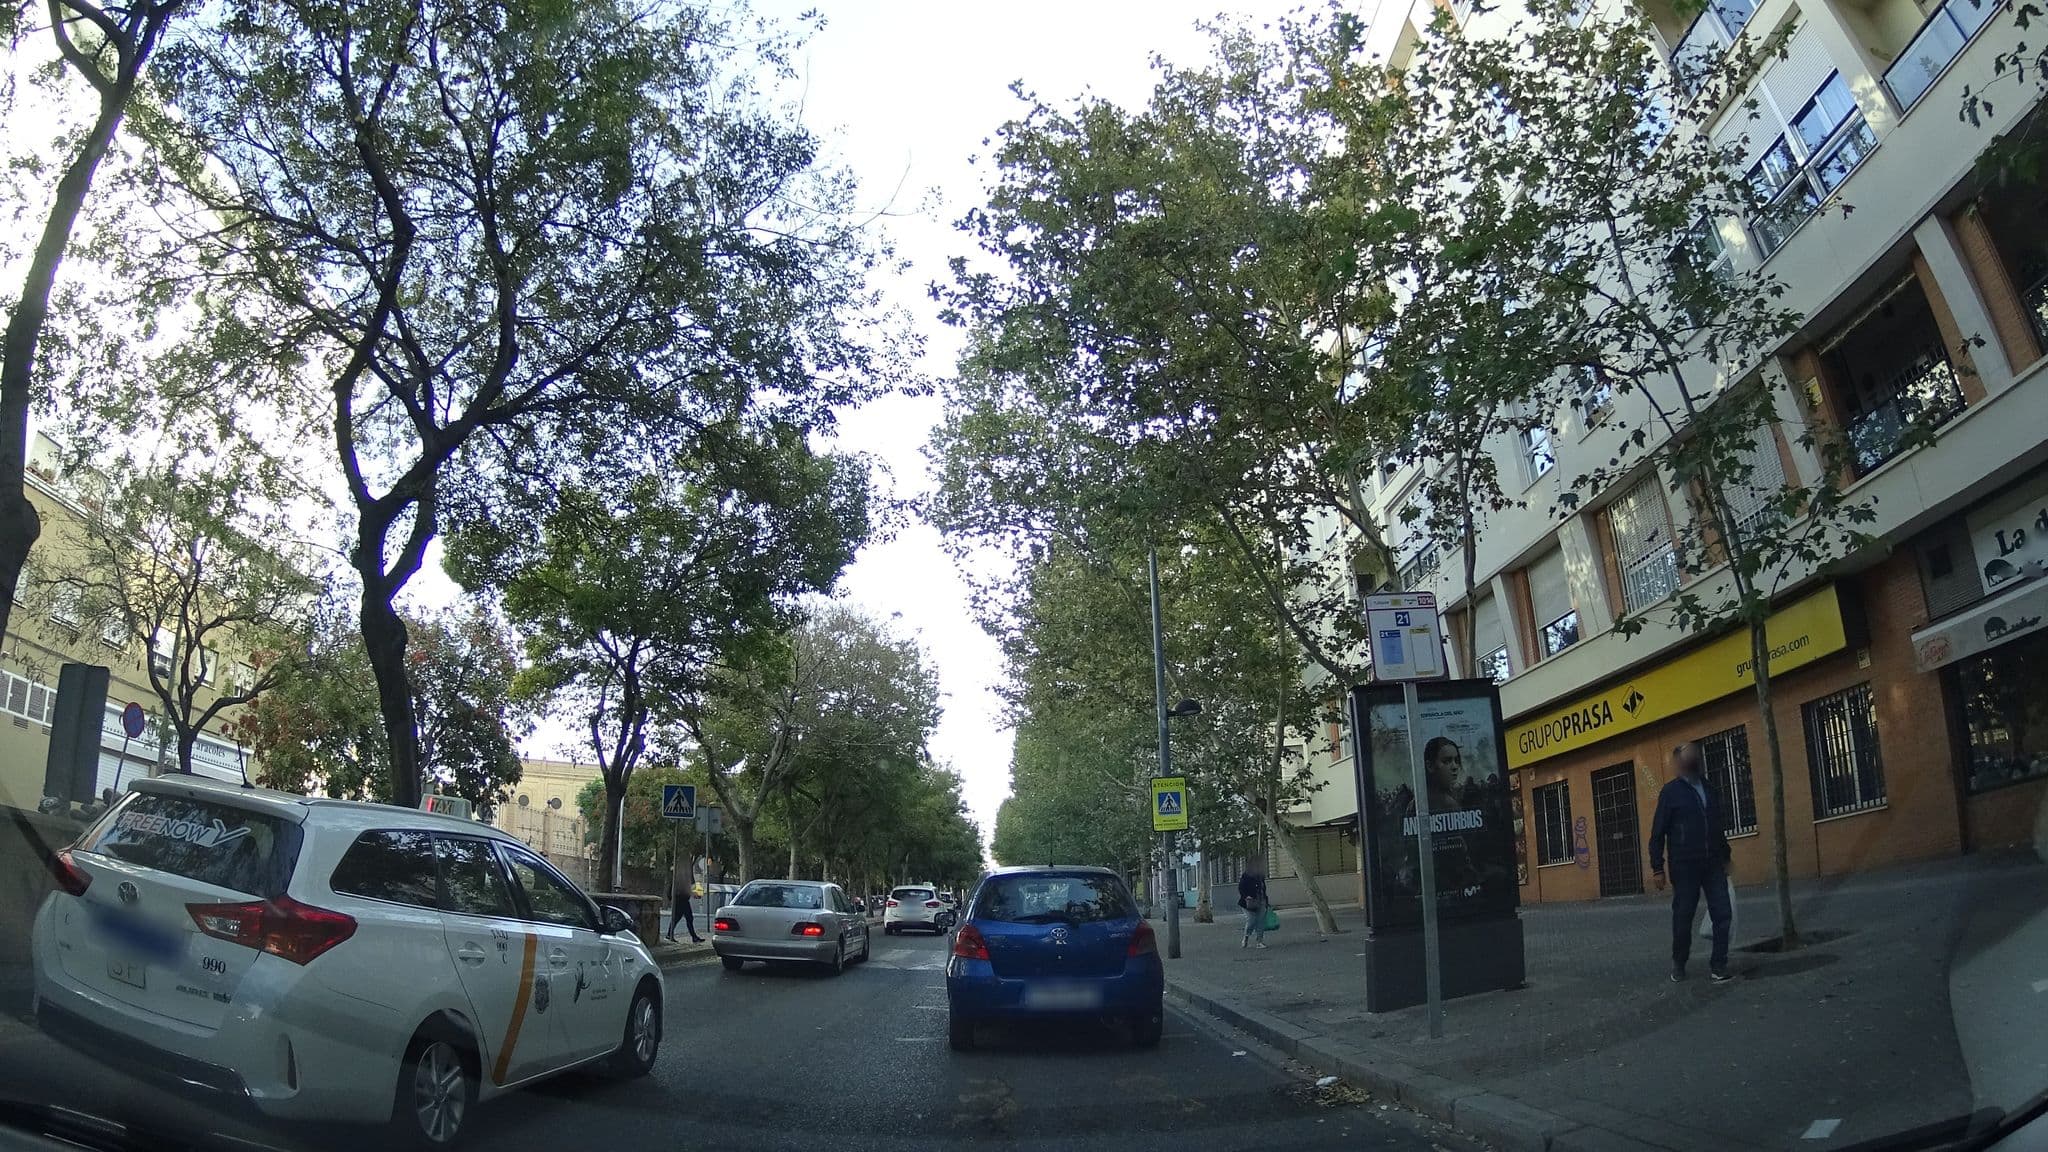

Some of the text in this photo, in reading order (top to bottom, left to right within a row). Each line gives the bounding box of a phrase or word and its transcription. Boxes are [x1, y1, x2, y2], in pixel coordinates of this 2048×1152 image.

[1995, 528, 2026, 557] La
[1397, 614, 1409, 624] 21
[1736, 634, 1810, 677] grurasa.com
[1518, 700, 1613, 754] GRUPOPRASA
[195, 742, 226, 759] aracoles
[202, 956, 226, 974] 990
